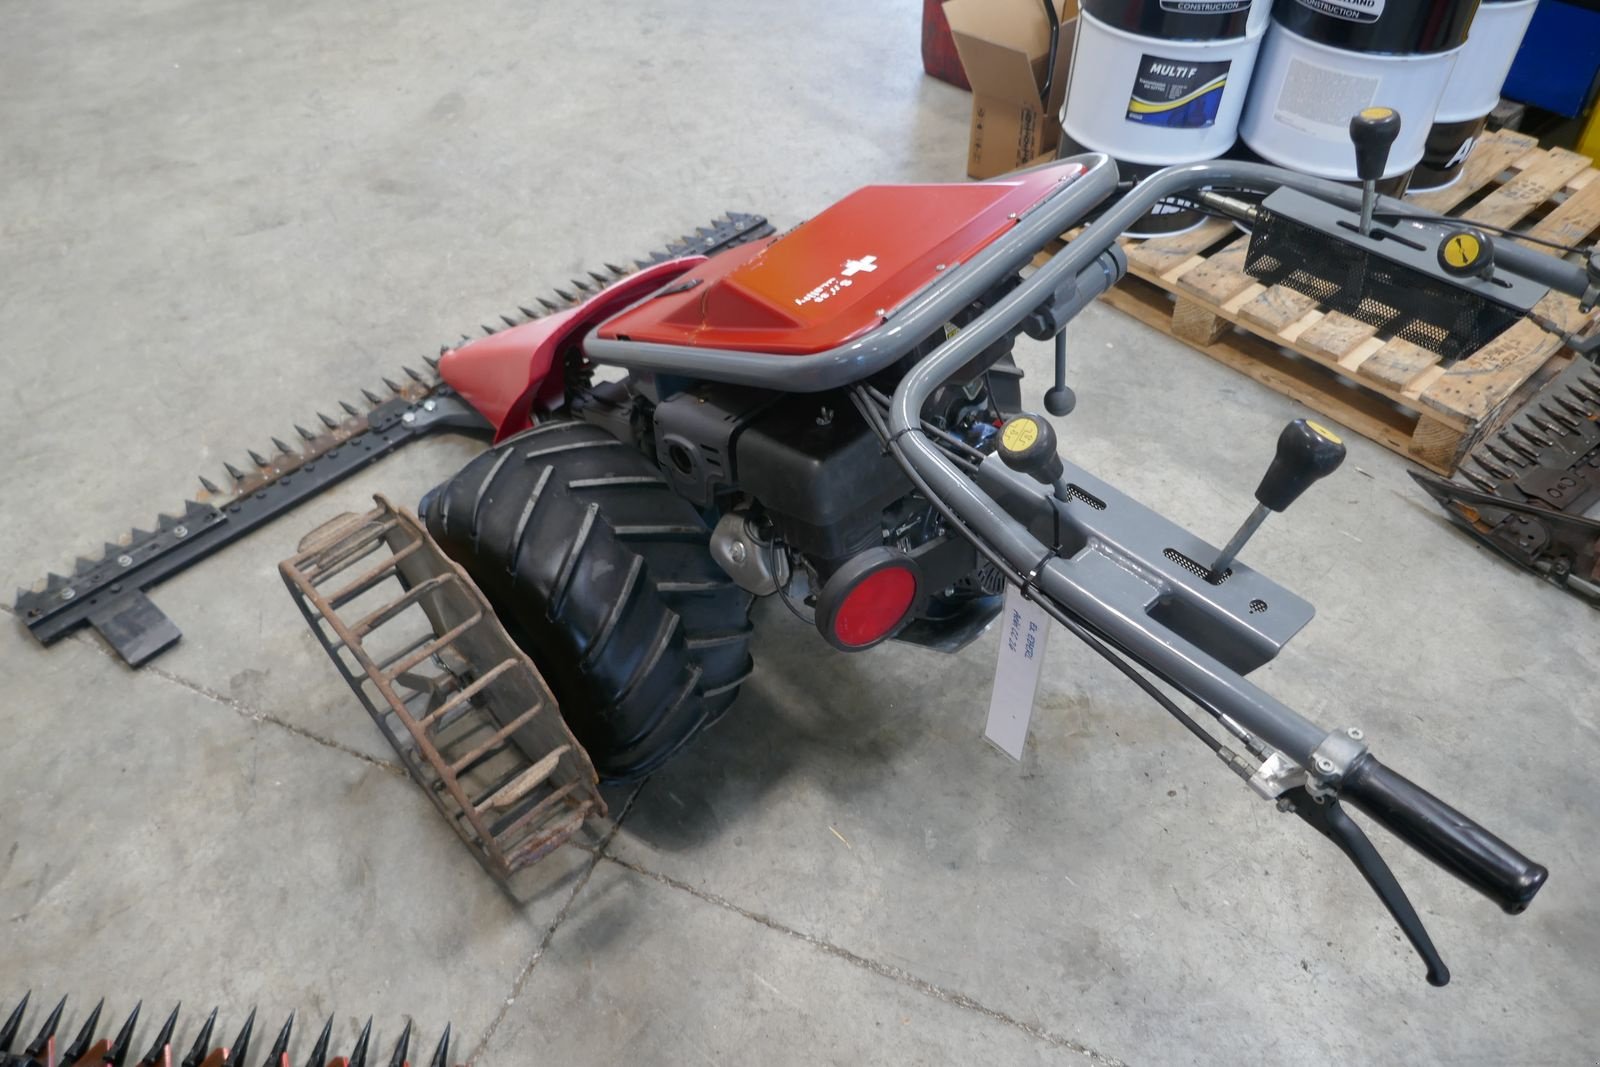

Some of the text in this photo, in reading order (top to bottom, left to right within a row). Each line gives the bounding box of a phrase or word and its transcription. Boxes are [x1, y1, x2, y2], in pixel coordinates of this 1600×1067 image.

[1177, 2, 1239, 11] CONSTRUCTION
[1149, 63, 1198, 79] MULTI F
